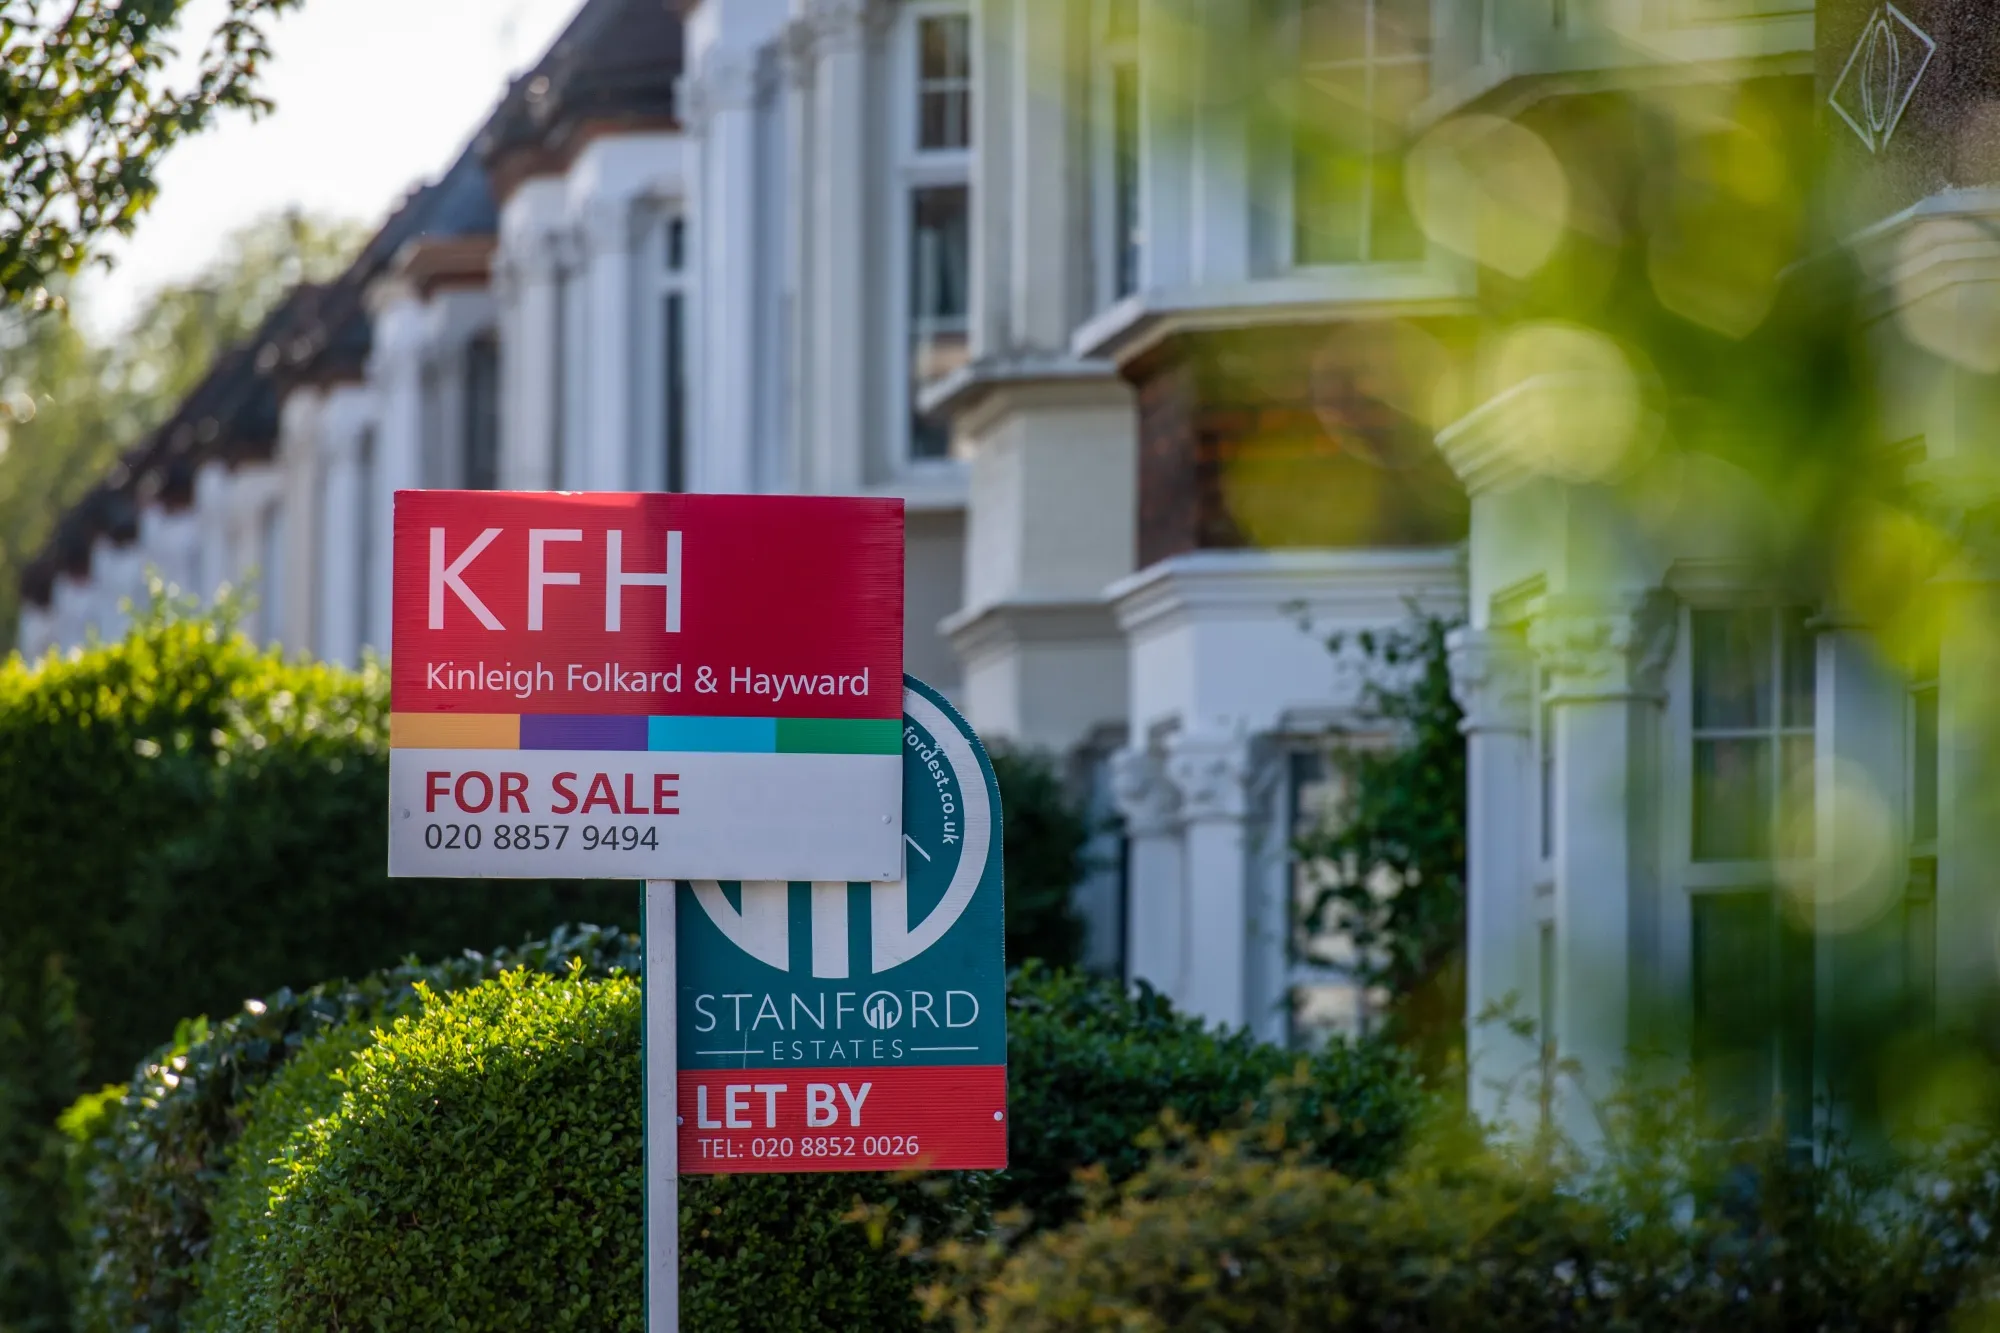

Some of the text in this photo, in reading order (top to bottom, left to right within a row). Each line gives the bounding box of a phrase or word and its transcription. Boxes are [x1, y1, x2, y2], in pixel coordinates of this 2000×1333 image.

[428, 527, 683, 633] KFH
[426, 661, 869, 702] Kinleigh Folkard & Hayward
[425, 771, 680, 815] FOR SALE
[425, 824, 660, 851] 020 8857 9494
[694, 990, 980, 1032] STANFORD
[772, 1039, 904, 1060] ESTATES
[697, 1082, 873, 1129] LET BY
[698, 1136, 919, 1158] TEL: 020 8852 0026
